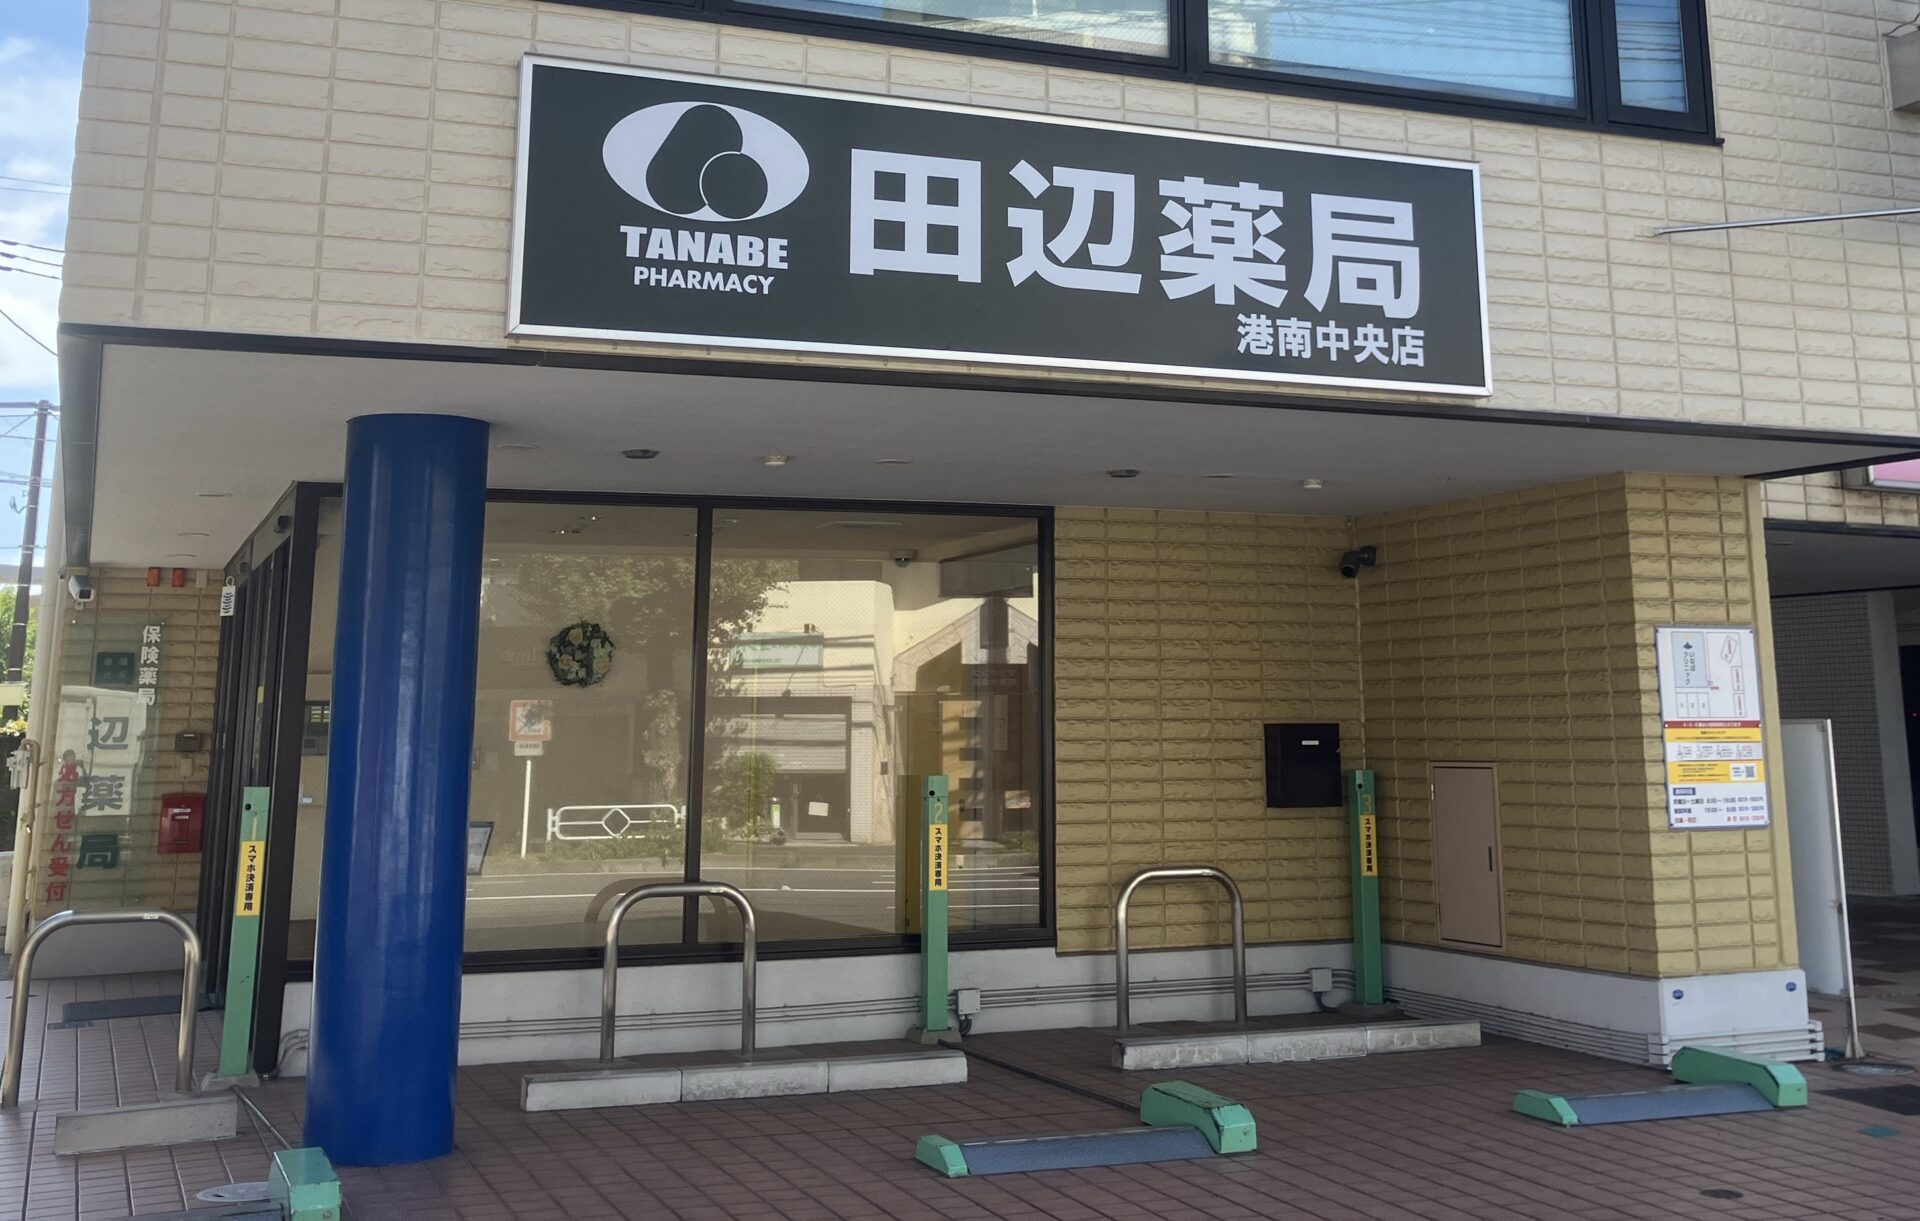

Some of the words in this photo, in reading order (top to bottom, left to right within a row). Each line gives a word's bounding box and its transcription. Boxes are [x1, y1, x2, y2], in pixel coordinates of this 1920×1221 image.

[619, 225, 789, 270] TANABE
[850, 147, 1421, 319] 田辺薬局
[633, 266, 775, 295] PHARMACY
[1236, 312, 1425, 367] 港南中央店
[137, 625, 161, 706] 保険薬局
[45, 762, 79, 905] 処方せん受付
[934, 827, 942, 887] スマホ決済専用
[243, 844, 257, 912] スマホ決済専用
